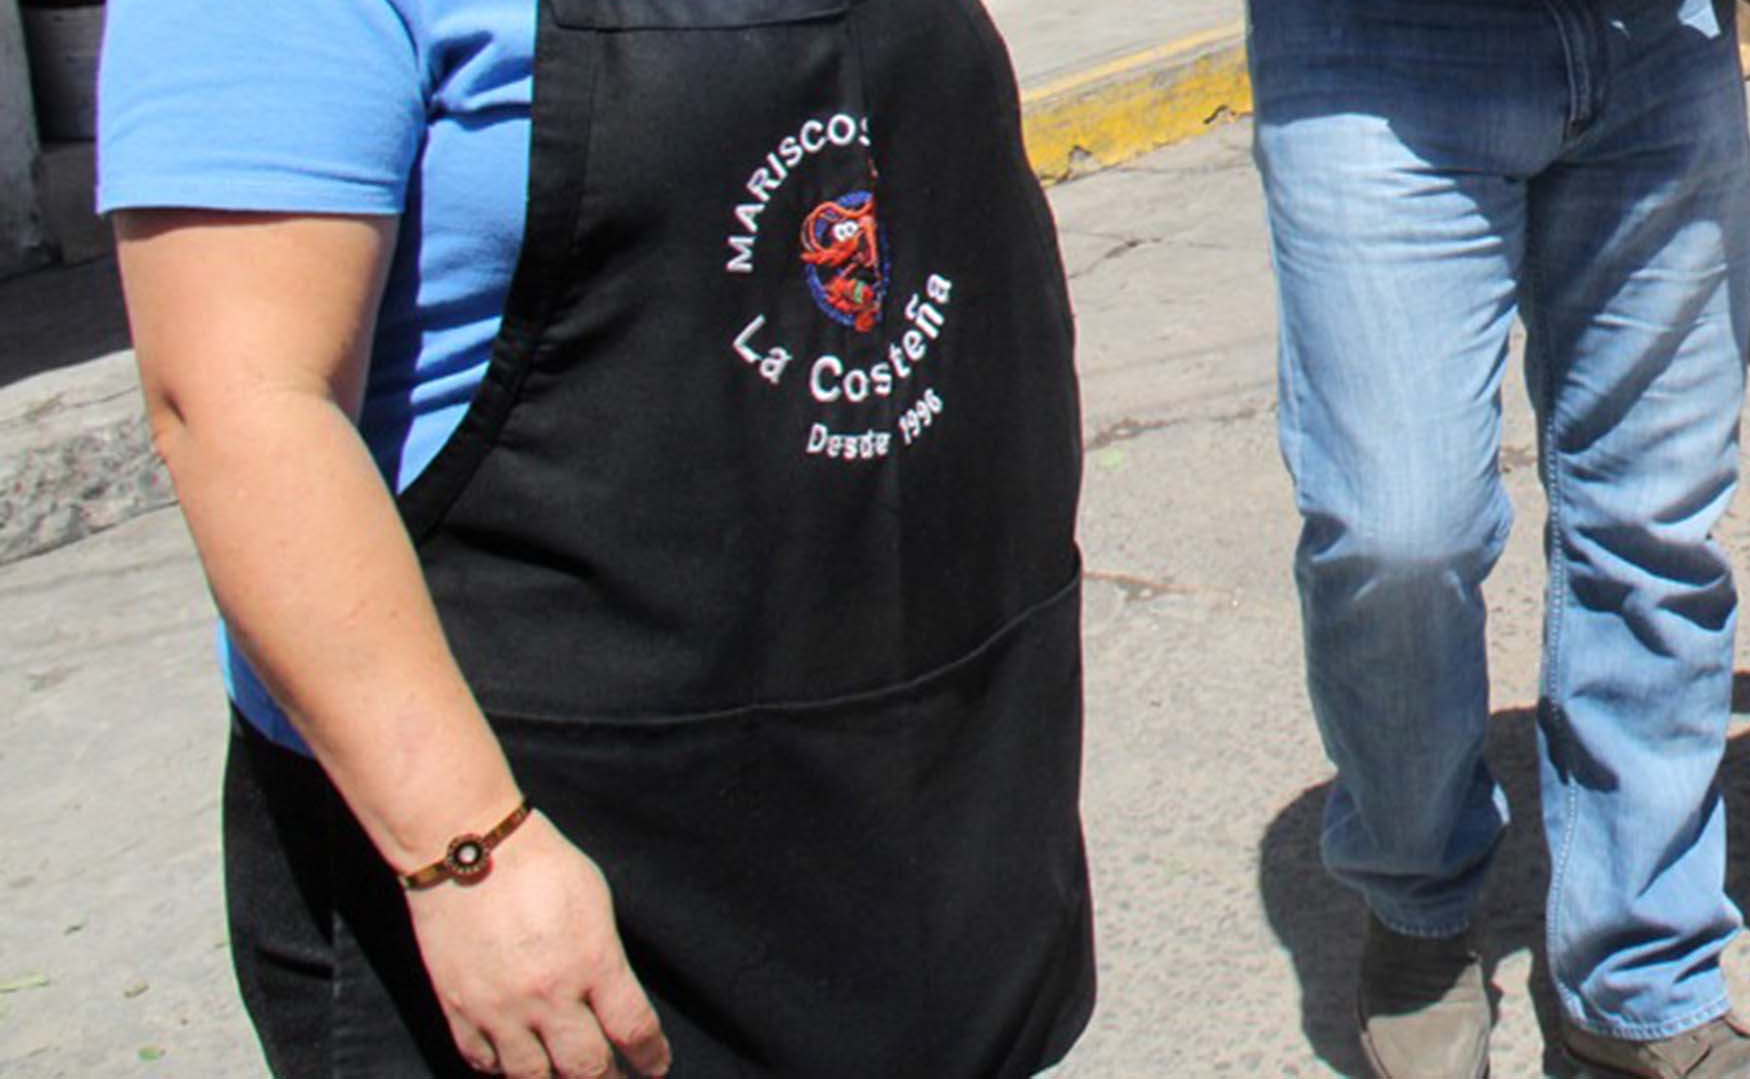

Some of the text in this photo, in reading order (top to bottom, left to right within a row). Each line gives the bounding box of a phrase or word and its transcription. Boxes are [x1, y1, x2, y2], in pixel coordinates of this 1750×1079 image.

[732, 273, 952, 402] La Costeña
[806, 387, 944, 460] Desde 1996
